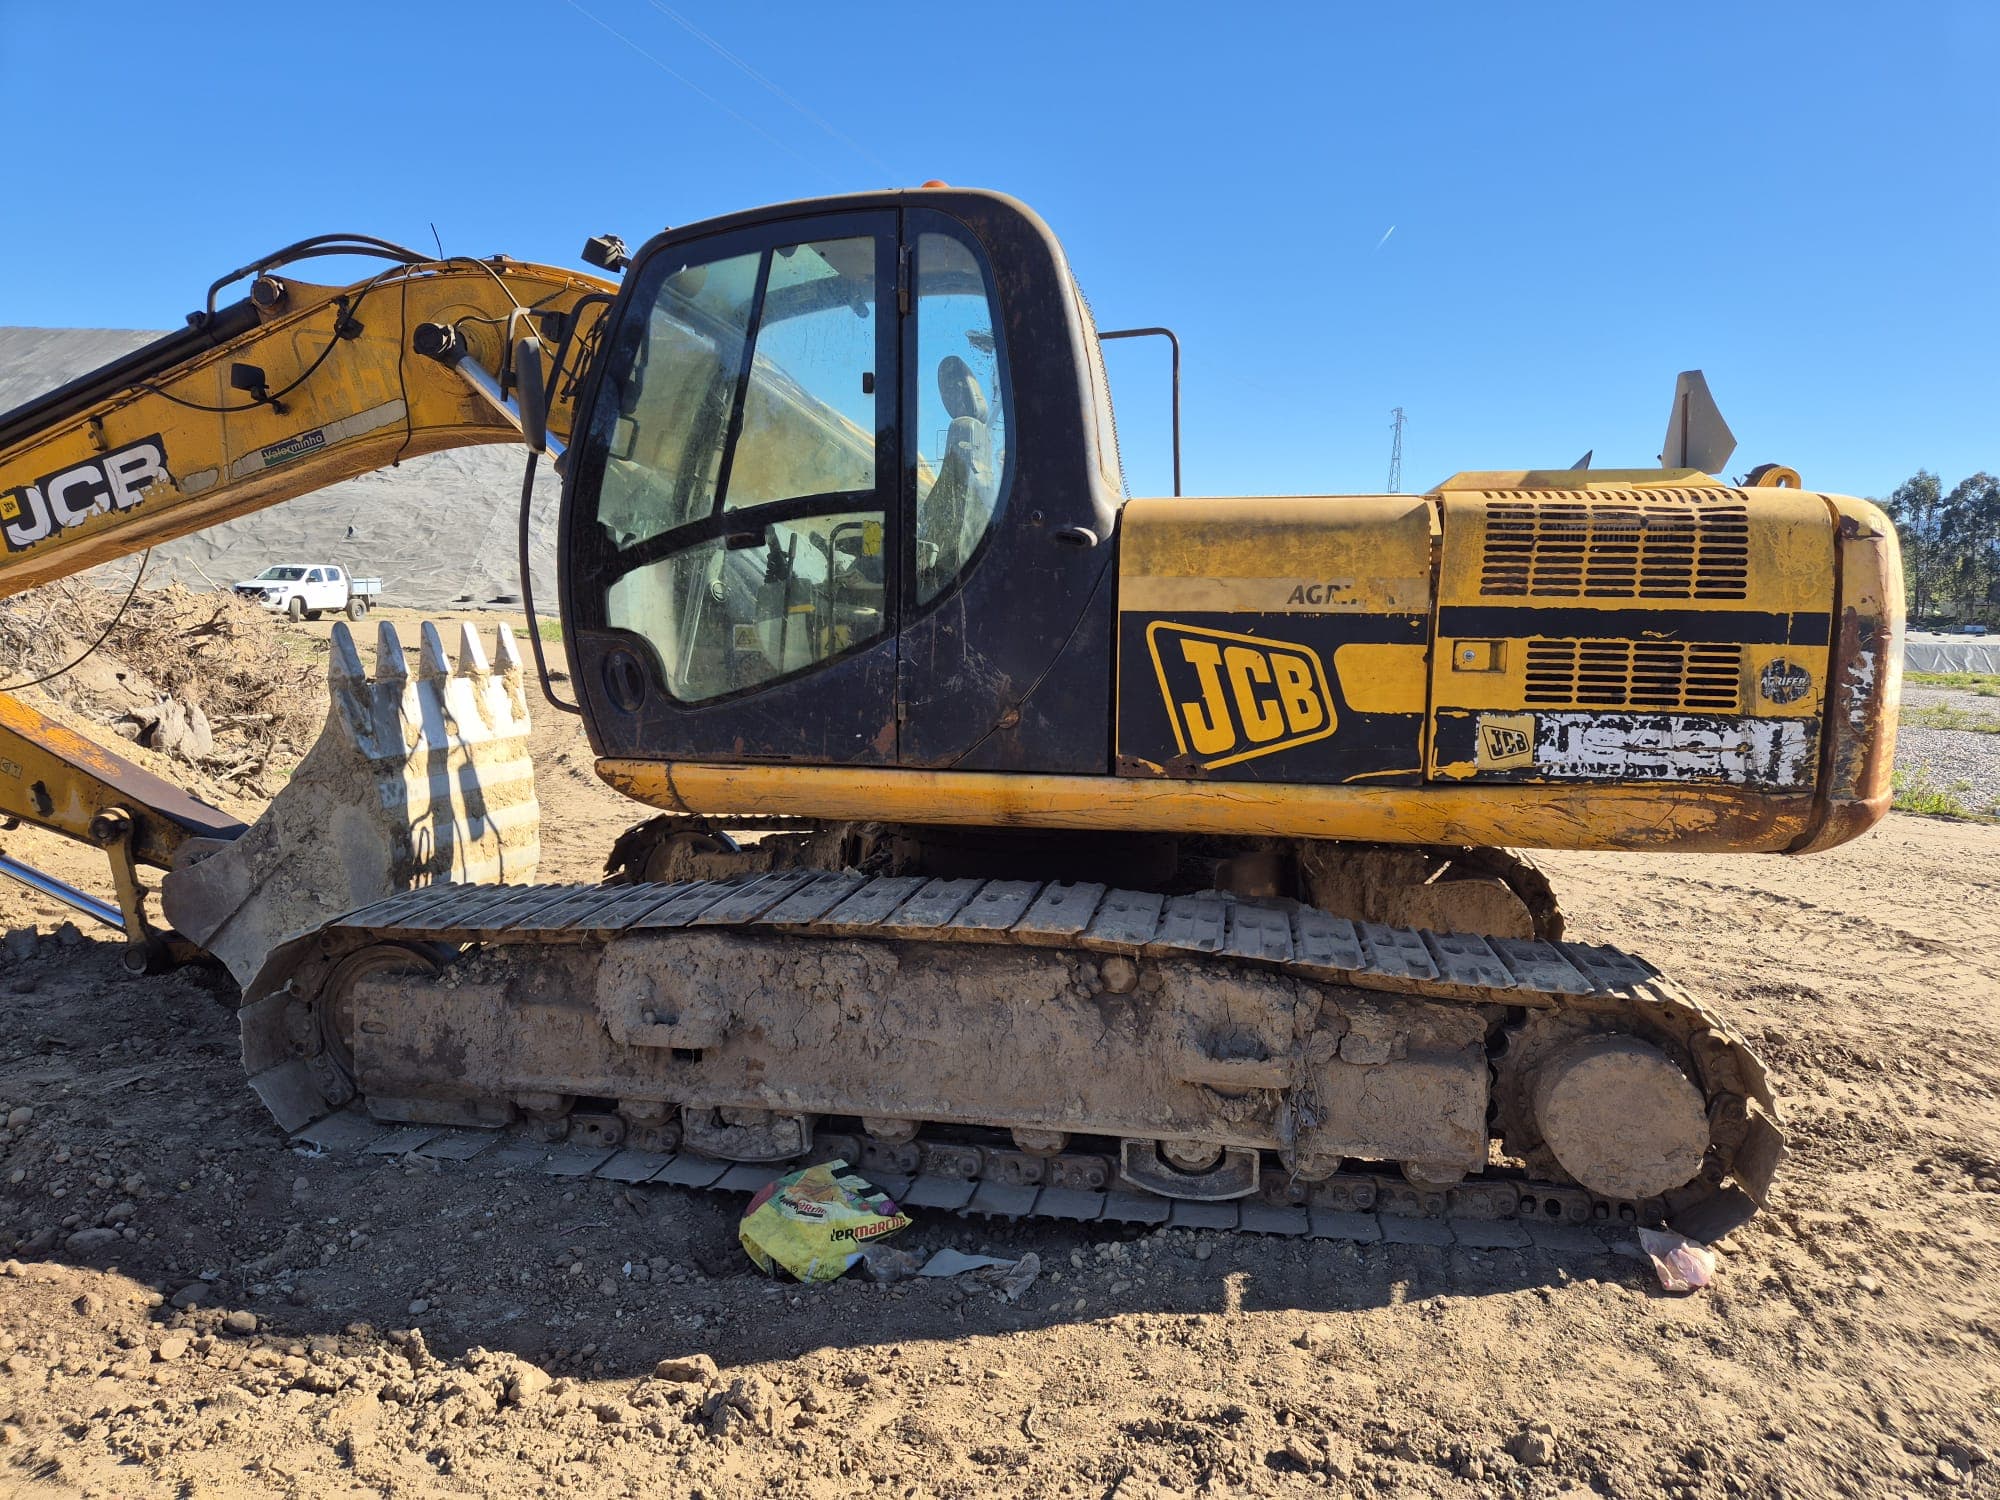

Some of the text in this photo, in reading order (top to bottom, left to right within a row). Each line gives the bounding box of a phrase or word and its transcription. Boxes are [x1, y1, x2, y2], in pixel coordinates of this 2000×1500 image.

[6, 444, 169, 546] JCB
[1180, 637, 1325, 755] JCB
[1490, 729, 1527, 757] JCB
